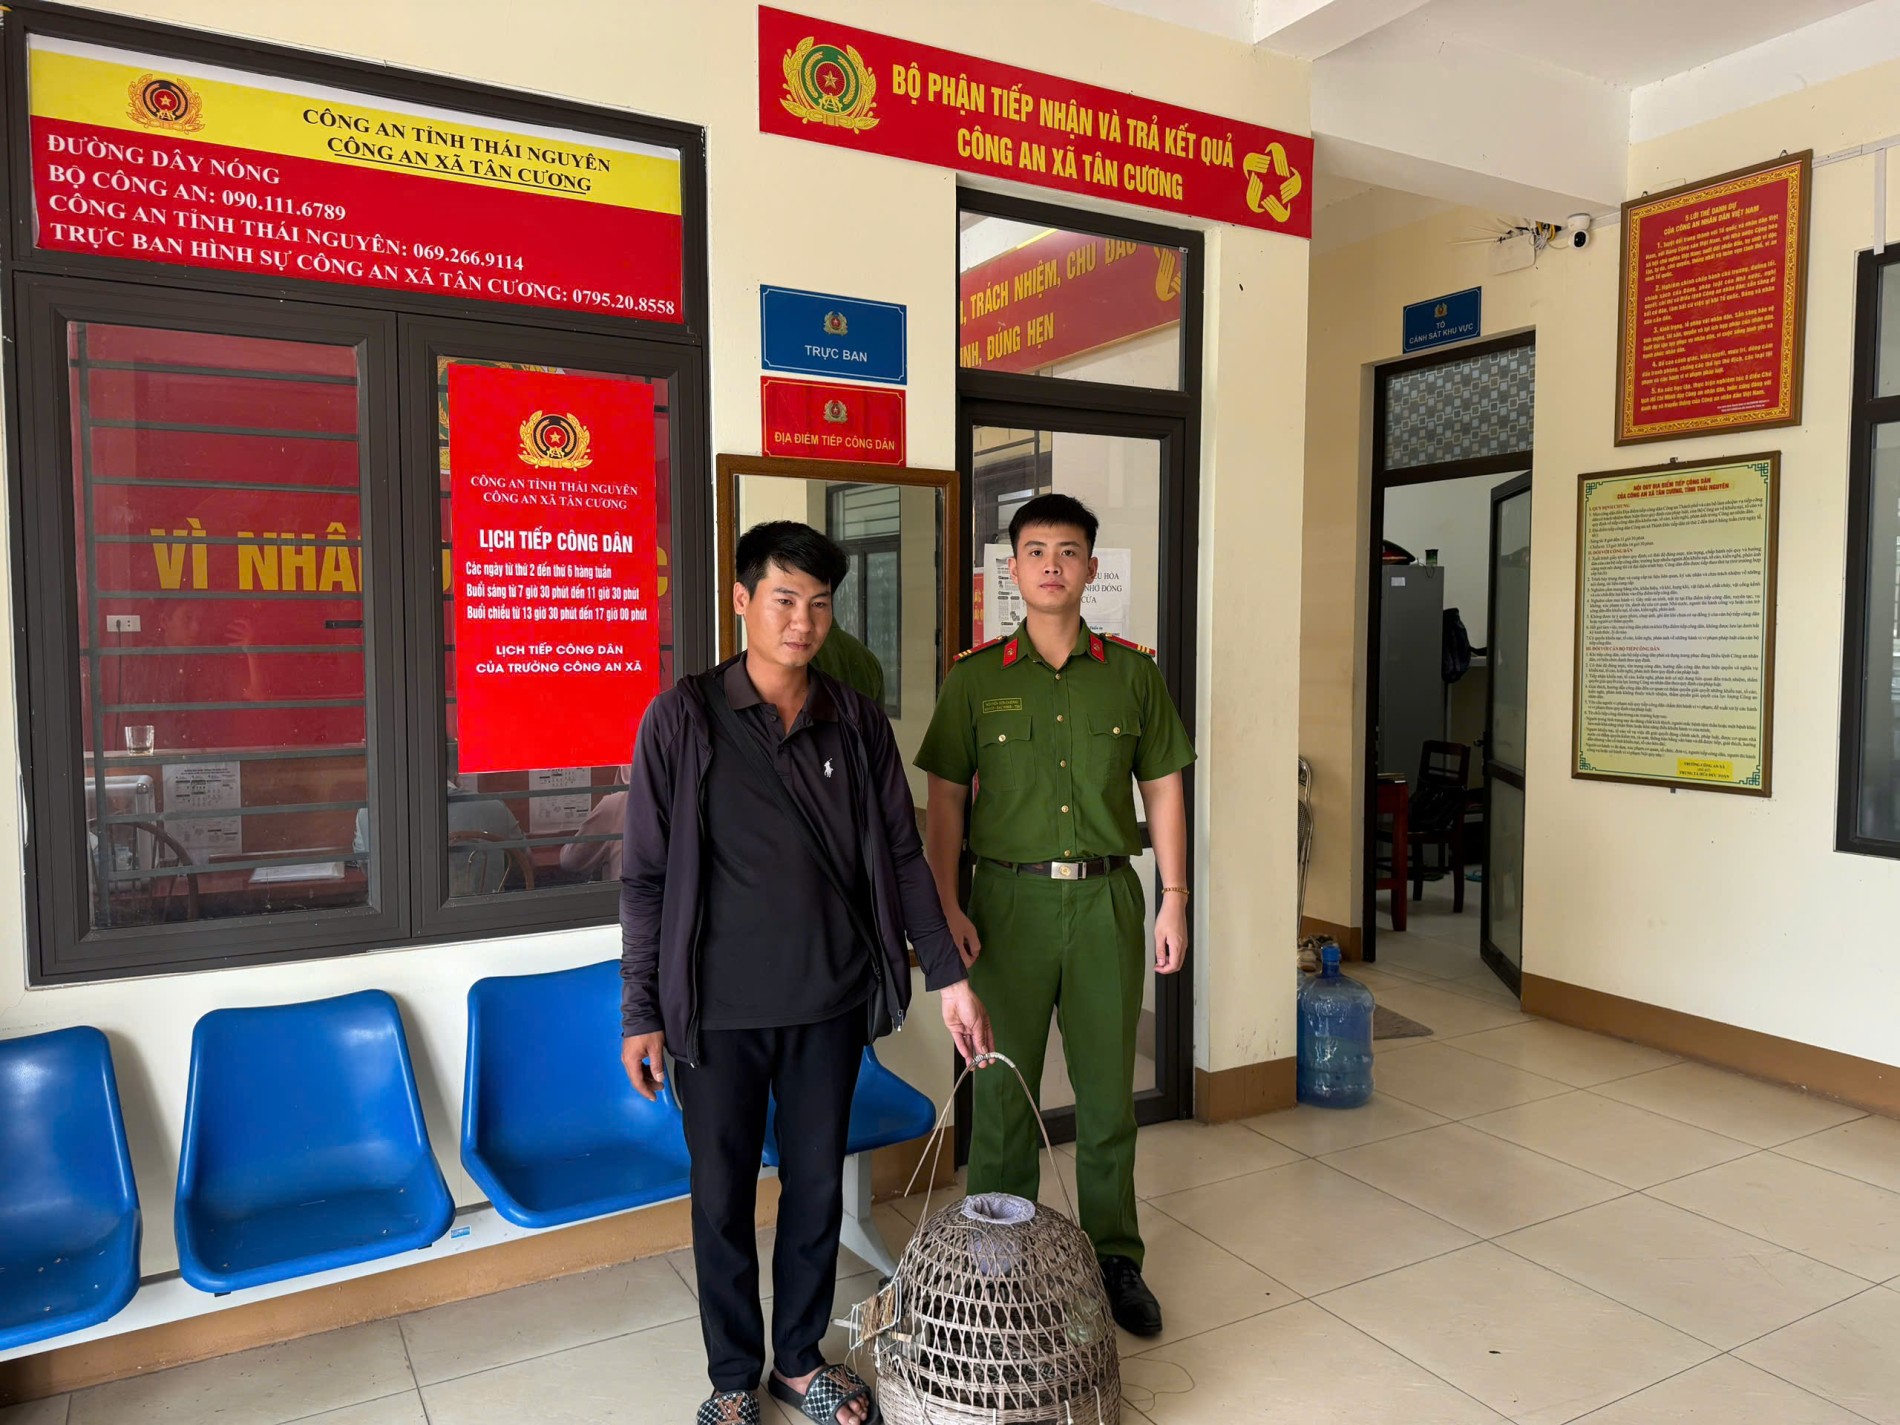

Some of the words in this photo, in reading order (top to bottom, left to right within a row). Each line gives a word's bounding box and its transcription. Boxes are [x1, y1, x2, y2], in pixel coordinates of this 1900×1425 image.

[892, 62, 920, 104] BỘ
[928, 74, 984, 114] PHẬN
[991, 83, 1033, 122] TIẾP
[1040, 98, 1092, 138] NHẬN
[1098, 108, 1121, 142] VÀ
[1126, 116, 1160, 150] TRẢ
[1164, 123, 1196, 160] KẾT
[1201, 133, 1234, 168] QUẢ
[302, 108, 370, 133] CÔNG
[376, 121, 405, 138] AN
[411, 124, 464, 149] TỈNH
[470, 134, 522, 158] THÁI
[528, 146, 611, 172] NGUYÊN
[48, 134, 144, 164] ĐƯỜNG
[152, 149, 204, 172] DÂY
[210, 158, 280, 184] NÓNG
[327, 136, 393, 161] CÔNG
[400, 150, 428, 166] AN
[434, 152, 464, 172] XÃ
[470, 156, 512, 178] TÂN
[518, 168, 592, 192] CƯƠNG
[958, 126, 1013, 166] CÔNG
[1018, 142, 1046, 172] AN
[1052, 144, 1077, 180] XÃ
[1082, 151, 1118, 188] TÂN
[1124, 163, 1183, 200] CƯƠNG
[48, 164, 86, 188] BỘ
[92, 169, 168, 196] CÔNG
[174, 186, 216, 204] AN:
[222, 190, 346, 220] 090.111.6789
[49, 193, 126, 219] CÔNG
[132, 206, 167, 224] AN
[173, 209, 235, 234] TỈNH
[241, 218, 300, 243] THÁI
[306, 226, 407, 256] NGUYÊN:
[413, 243, 524, 271] 069.266.9114
[50, 222, 124, 248] TRỰC
[133, 234, 183, 255] BAN
[192, 239, 254, 264] HÌNH
[260, 249, 291, 270] SỰ
[297, 254, 363, 278] CÔNG
[368, 265, 398, 281] AN
[404, 266, 434, 286] XÃ
[439, 270, 482, 292] TÂN
[488, 278, 568, 302] CƯƠNG:
[572, 288, 674, 315] 0795.20.8558
[970, 283, 1008, 320] TRÁCH
[1014, 260, 1061, 302] NHIỆM,
[987, 327, 1020, 361] ĐÚNG
[1028, 312, 1054, 348] HẸN
[1409, 335, 1428, 344] CẢNH
[1428, 330, 1442, 340] SÁT
[1443, 327, 1457, 336] KHU
[1458, 323, 1474, 332] VỰC
[804, 345, 839, 360] TRỰC
[843, 350, 868, 362] BAN
[774, 432, 792, 444] ĐỊA
[845, 436, 872, 449] CÔNG
[876, 438, 895, 450] DÂN
[470, 475, 506, 488] CÔNG
[509, 479, 525, 488] AN
[560, 480, 588, 493] THÁI
[591, 484, 638, 496] NGUYÊN
[483, 492, 518, 504] CÔNG
[521, 495, 538, 504] AN
[540, 494, 556, 506] XÃ
[559, 496, 583, 506] TÂN
[586, 498, 627, 510] CƯƠNG
[480, 529, 514, 552] LỊCH
[519, 526, 552, 550] TIẾP
[557, 530, 598, 552] CÔNG
[602, 531, 633, 553] DÂN
[150, 517, 208, 589] VÌ
[238, 522, 362, 592] NHÂ
[466, 561, 482, 576] Các
[484, 562, 503, 577] ngày
[505, 562, 514, 576] từ
[515, 564, 528, 576] thứ
[530, 564, 534, 576] 2
[537, 564, 551, 576] đến
[554, 564, 566, 576] thứ
[568, 566, 572, 576] 6
[574, 565, 593, 579] hàng
[595, 564, 612, 578] tuần
[466, 581, 485, 597] Buổi
[488, 585, 506, 599] sáng
[508, 584, 518, 597] từ
[518, 585, 524, 597] 7
[526, 586, 538, 600] giờ
[540, 586, 550, 598] 30
[552, 585, 570, 600] phút
[571, 584, 584, 599] đến
[587, 586, 596, 598] 11
[599, 588, 610, 600] giờ
[612, 587, 622, 599] 30
[624, 587, 640, 600] phút
[1084, 583, 1100, 592] NHỚ
[1102, 583, 1122, 592] ĐÓNG
[467, 604, 486, 620] Buổi
[488, 606, 510, 620] chiều
[512, 606, 520, 620] từ
[522, 607, 532, 620] 13
[534, 608, 546, 621] giờ
[548, 607, 558, 620] 30
[560, 607, 578, 620] phút
[579, 606, 593, 620] đến
[595, 608, 604, 620] 17
[606, 608, 618, 621] giờ
[620, 608, 630, 620] 00
[630, 608, 648, 621] phút
[496, 646, 524, 658] LỊCH
[528, 642, 552, 654] TIẾP
[556, 644, 594, 655] CÔNG
[598, 644, 623, 654] DÂN
[476, 660, 504, 674] CỦA
[508, 660, 560, 672] TRƯỞNG
[563, 661, 600, 672] CÔNG
[604, 663, 622, 672] AN
[626, 660, 642, 671] XÃ
